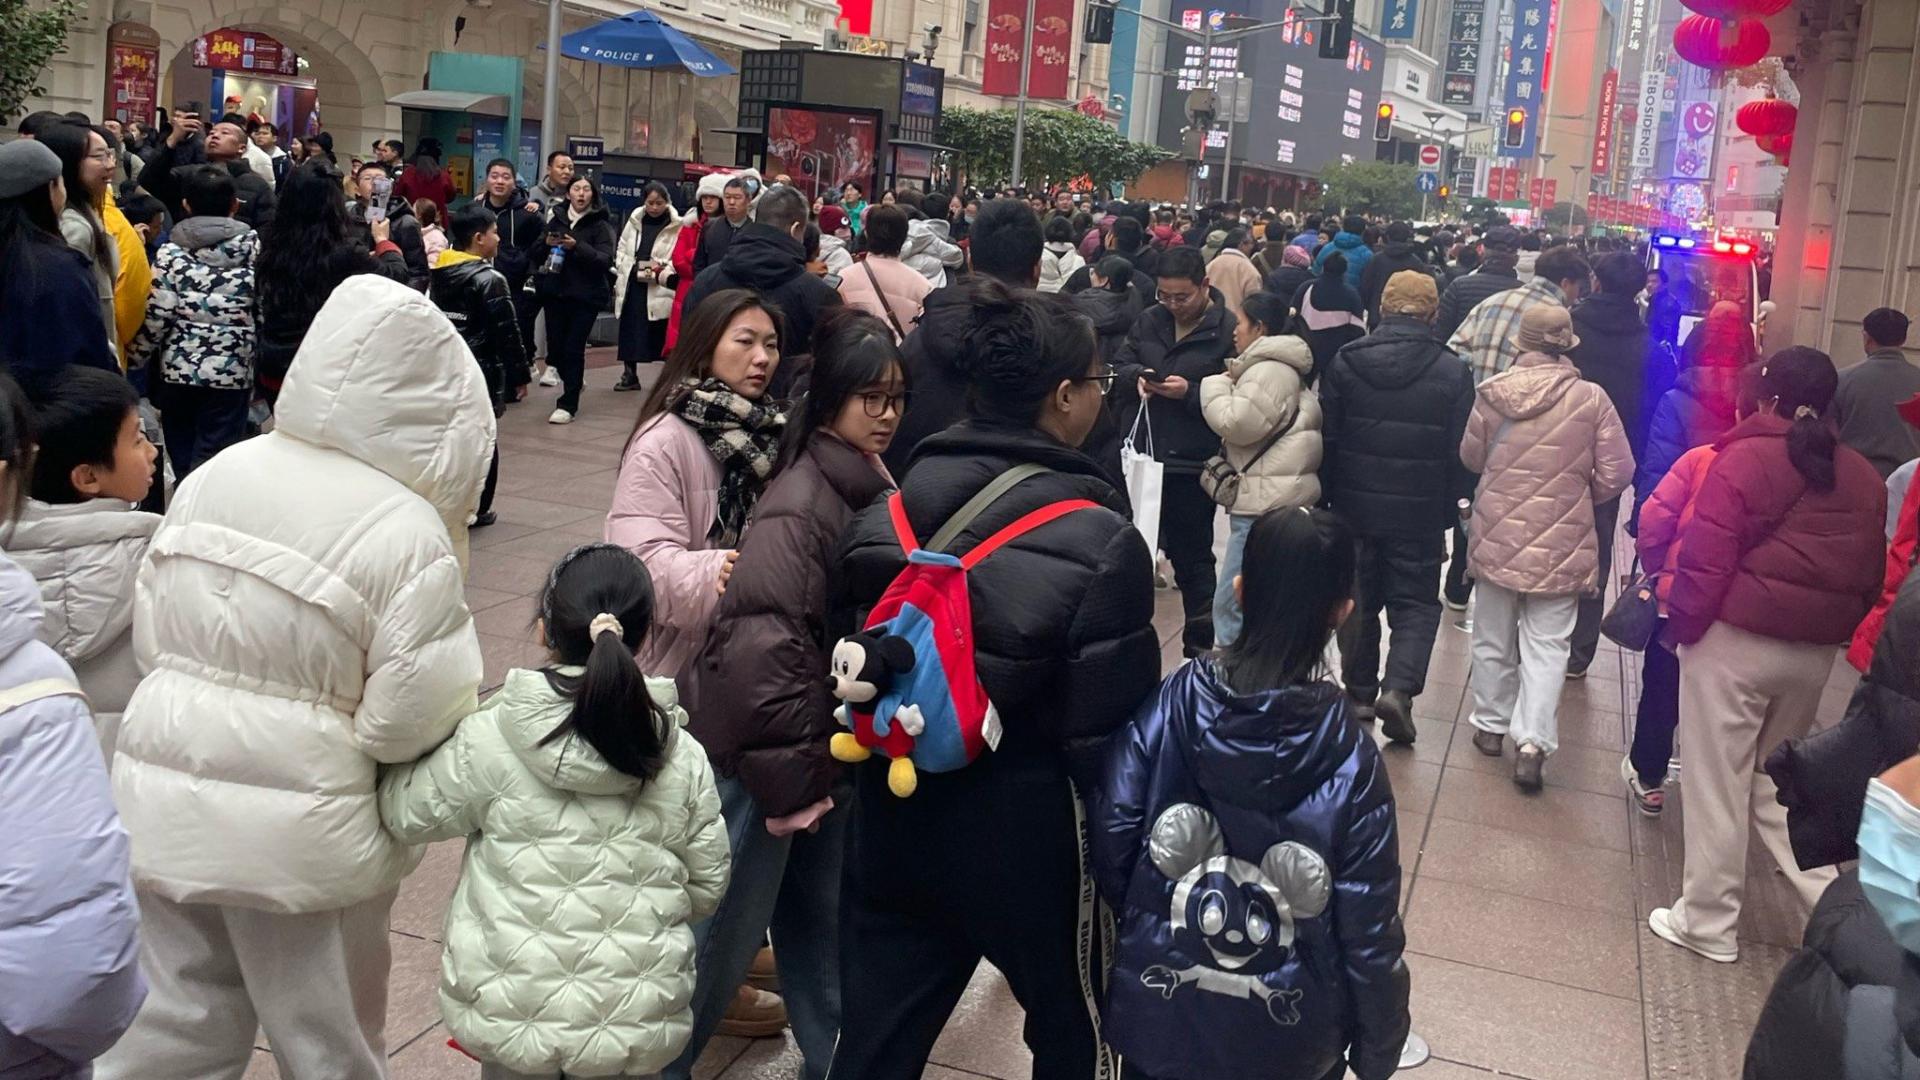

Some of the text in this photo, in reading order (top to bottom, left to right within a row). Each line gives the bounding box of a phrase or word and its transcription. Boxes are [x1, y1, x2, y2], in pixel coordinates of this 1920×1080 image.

[595, 48, 640, 62] POLICE
[1456, 12, 1480, 73] 真丝大王
[1639, 86, 1657, 156] BOSIDENG
